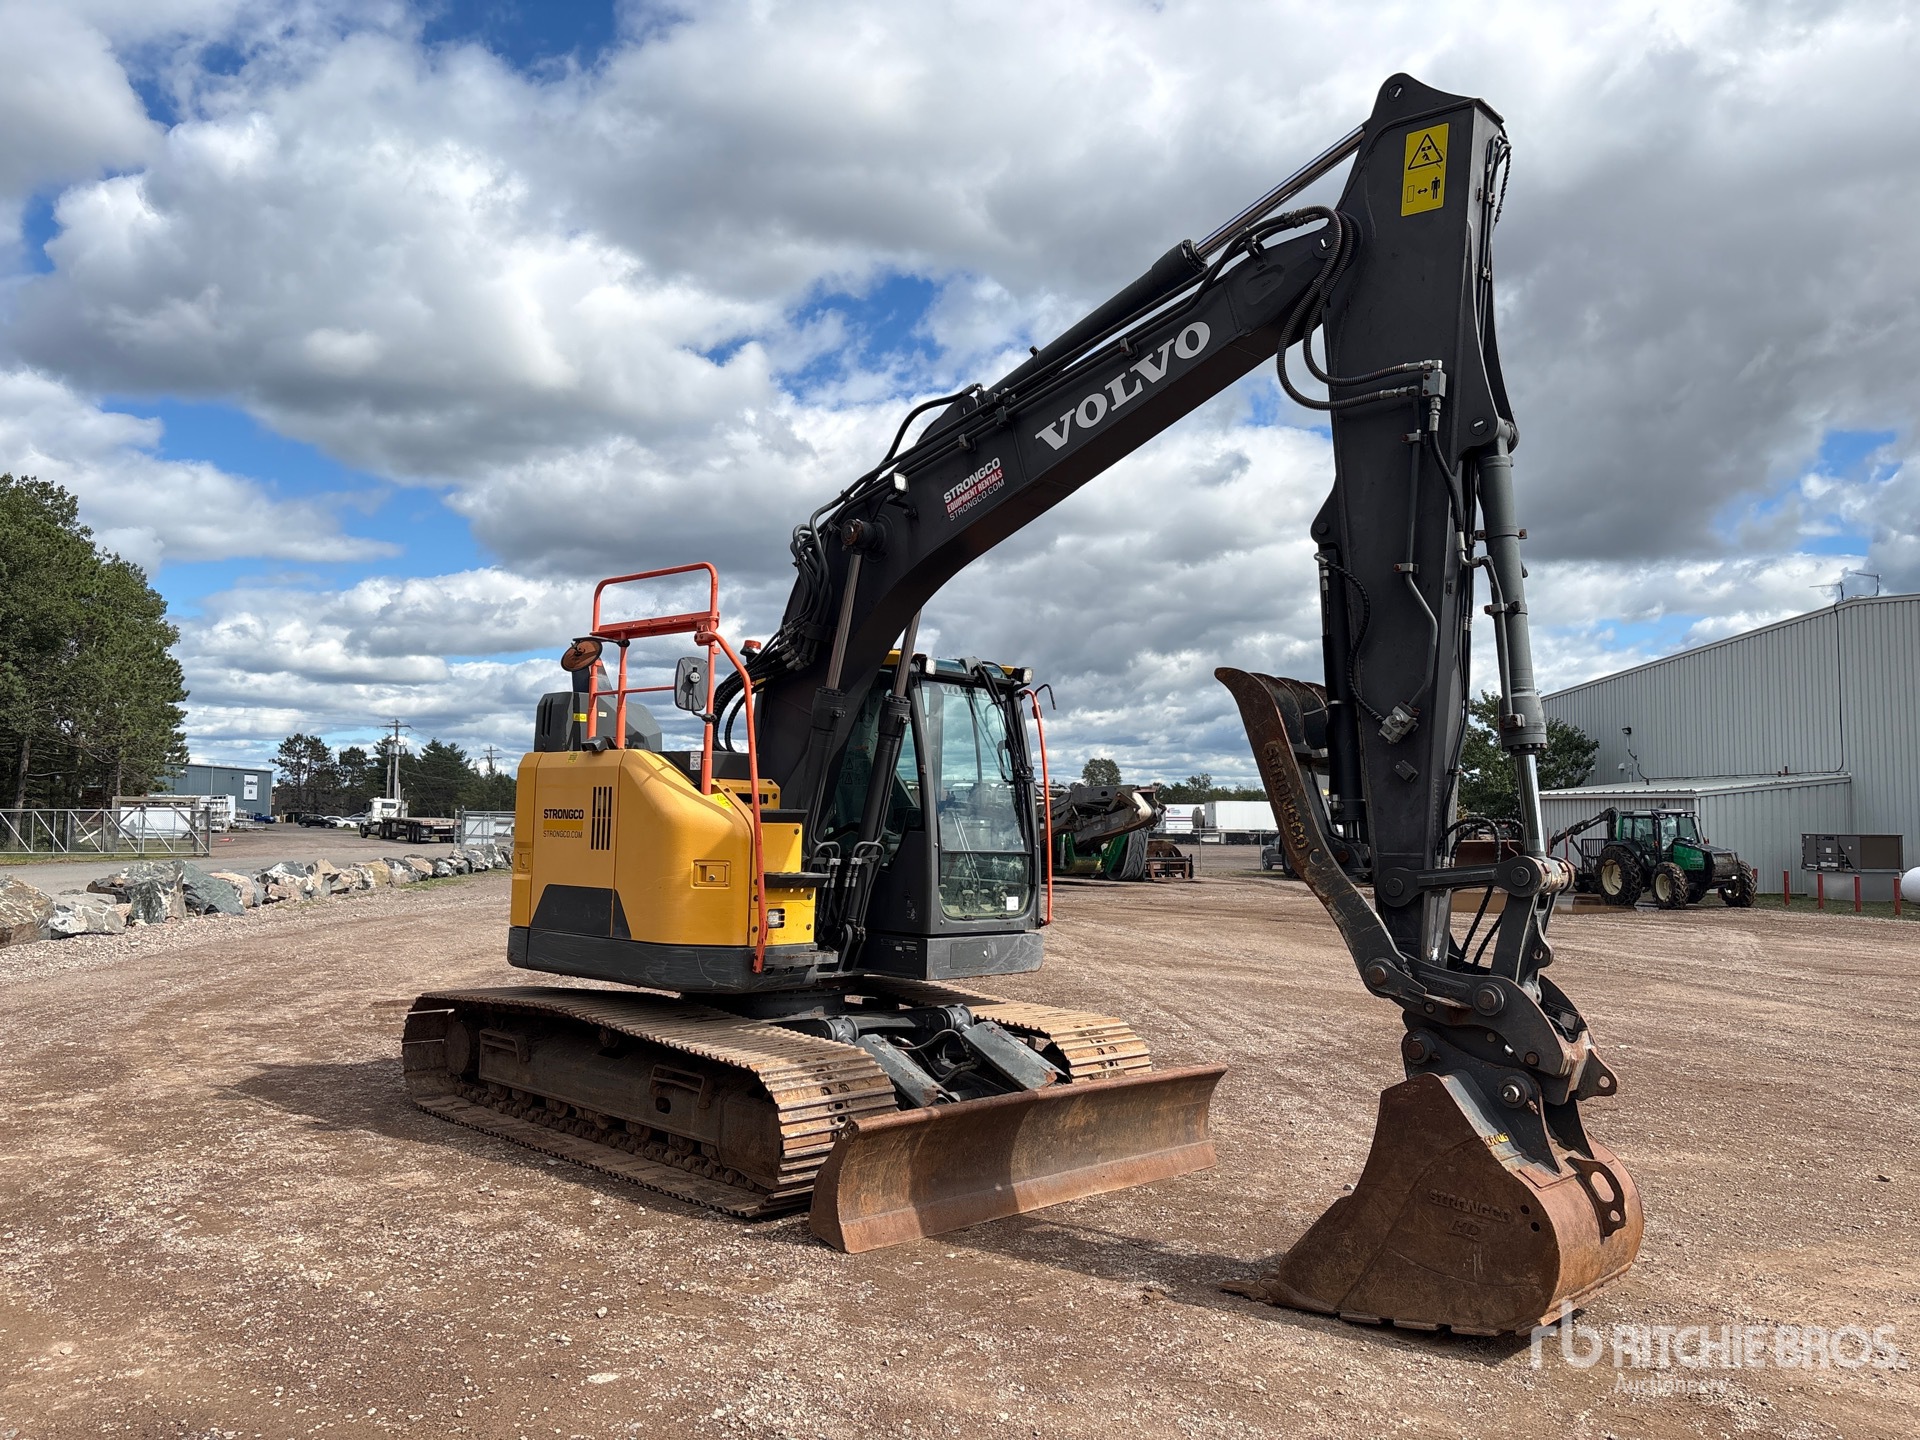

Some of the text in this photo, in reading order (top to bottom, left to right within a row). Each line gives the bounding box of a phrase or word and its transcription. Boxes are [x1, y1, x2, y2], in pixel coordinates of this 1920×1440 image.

[1035, 321, 1211, 451] VOLVO
[943, 457, 1001, 504] STRONGCO
[946, 469, 1003, 513] EQUIPMENT RENTALS
[949, 478, 1005, 522] STRONGCO.COM
[938, 683, 992, 700] VOO
[543, 808, 584, 820] STRONGCO
[543, 830, 583, 839] STRONGCO.COM
